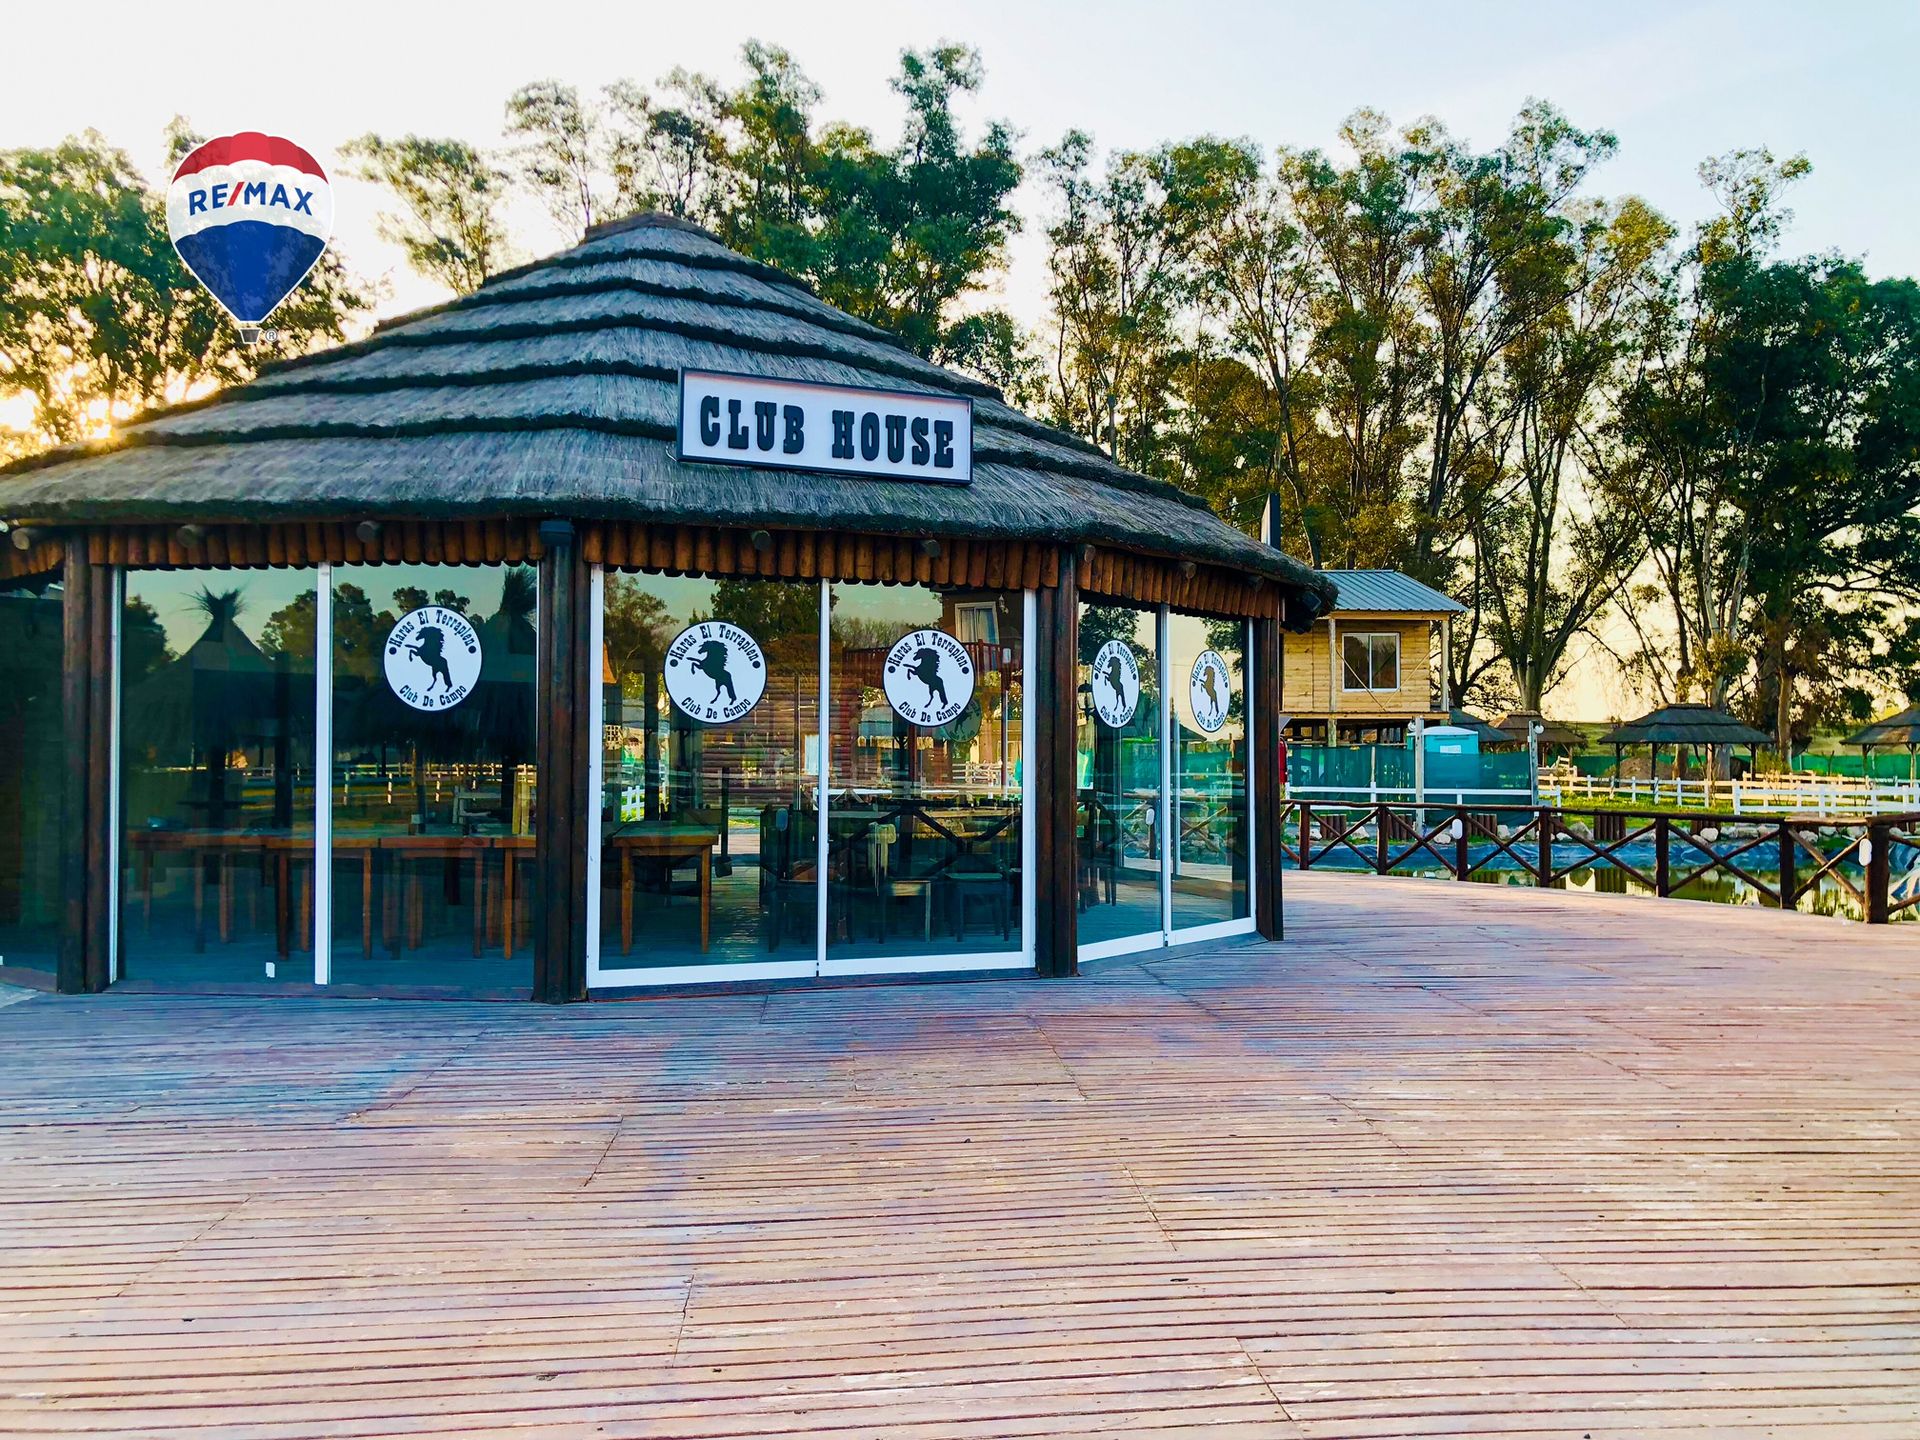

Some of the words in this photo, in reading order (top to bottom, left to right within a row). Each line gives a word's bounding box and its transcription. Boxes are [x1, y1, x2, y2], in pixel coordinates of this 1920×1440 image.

[700, 395, 804, 454] CLUB
[832, 409, 953, 468] HOUSE
[388, 621, 415, 647] Haras
[417, 610, 429, 625] El
[436, 610, 475, 647] Terraplen
[669, 634, 697, 660] Haras
[700, 625, 712, 639] El
[719, 624, 759, 661] Terraplen
[888, 642, 912, 667] Haras
[914, 633, 925, 646] El
[932, 633, 968, 667] Terraplen
[400, 685, 418, 703] Club
[422, 695, 434, 707] De
[440, 685, 467, 705] Campo
[681, 697, 701, 715] Club
[706, 708, 717, 719] De
[723, 698, 751, 718] Campo
[899, 701, 917, 718] Club
[920, 712, 931, 722] De
[936, 702, 961, 721] Campo
